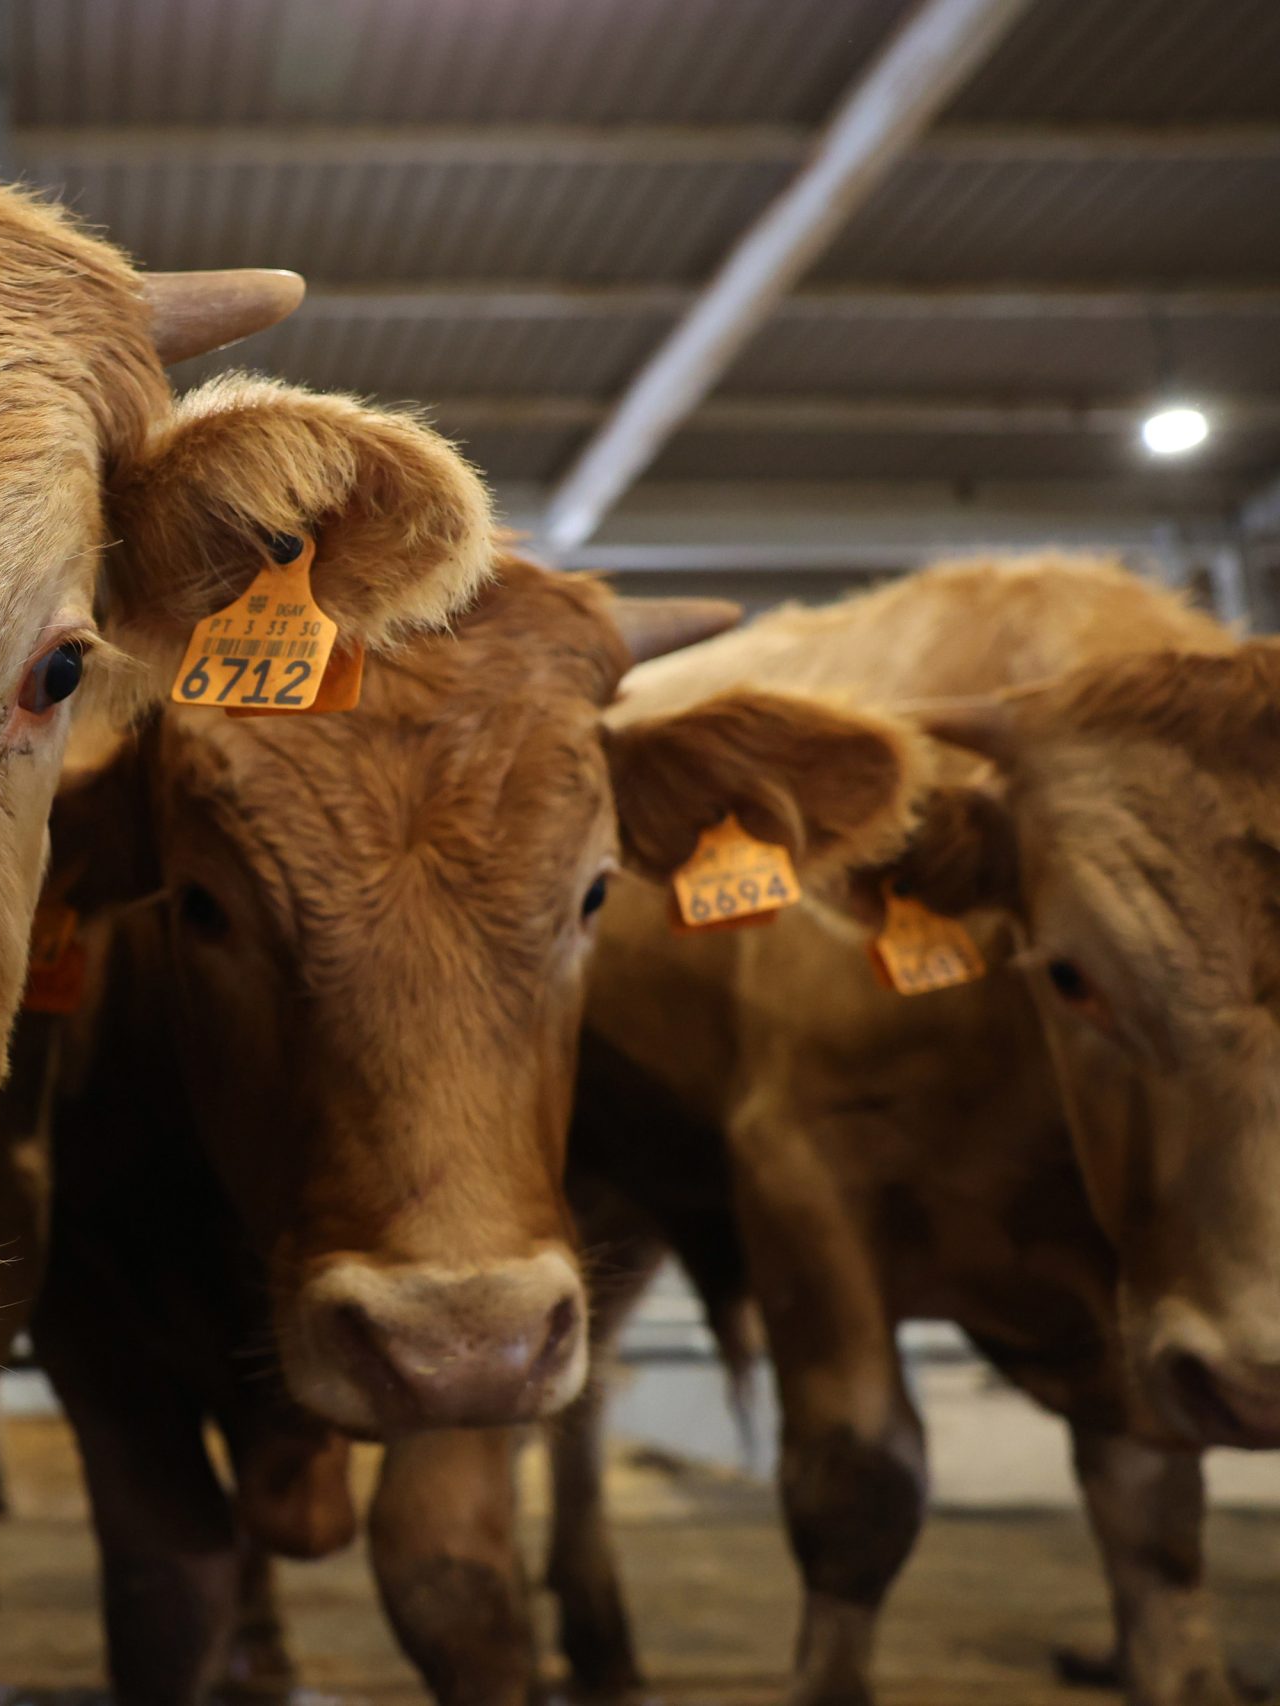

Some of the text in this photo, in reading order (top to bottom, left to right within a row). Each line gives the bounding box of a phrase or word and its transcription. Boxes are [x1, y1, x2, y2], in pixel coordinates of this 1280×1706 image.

[244, 621, 254, 634] 3
[266, 621, 288, 635] 33
[299, 622, 320, 636] 30
[181, 656, 311, 704] 6712
[691, 874, 788, 919] 6694
